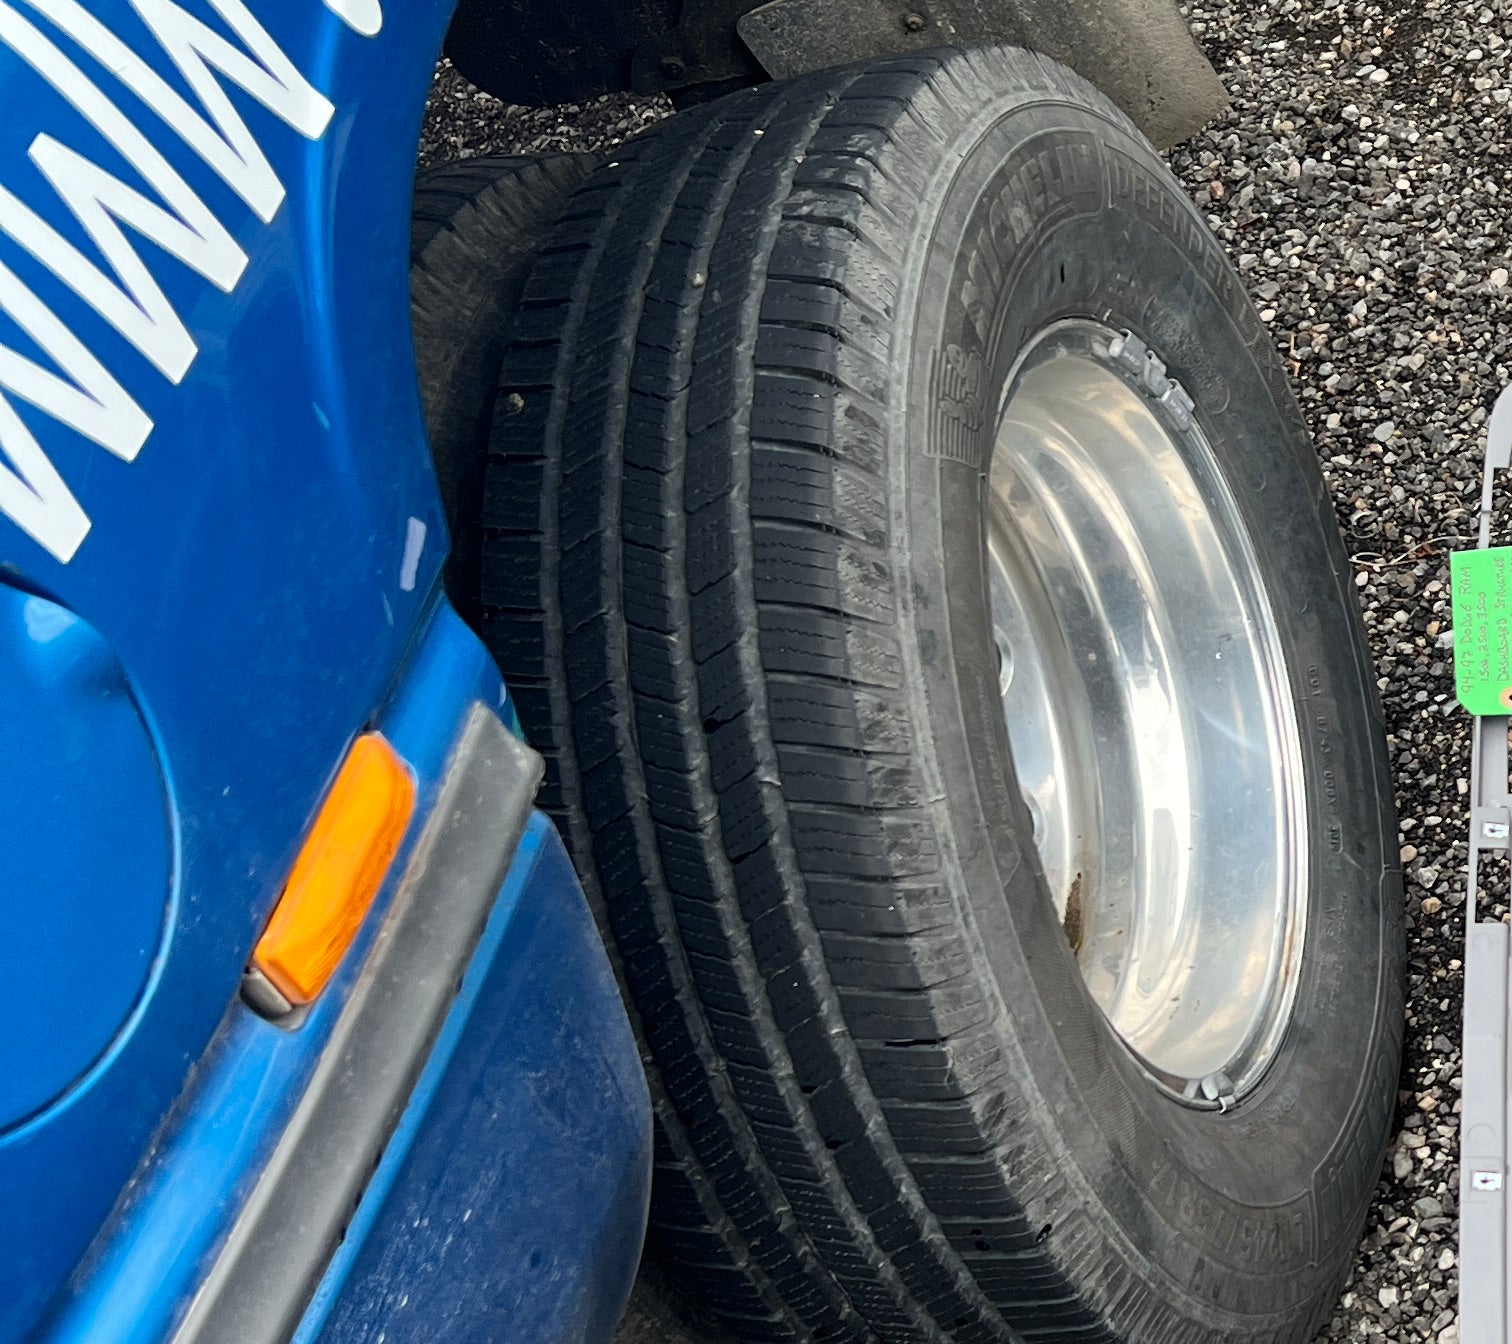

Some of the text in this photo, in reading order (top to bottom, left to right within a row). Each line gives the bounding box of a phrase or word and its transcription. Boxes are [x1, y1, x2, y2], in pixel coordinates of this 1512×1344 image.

[1113, 158, 1233, 301] DEFENDER
[1458, 565, 1472, 596] RAM
[1476, 591, 1488, 620] 3500
[1493, 555, 1510, 682] DASHBOARD STRUCTURE
[1461, 650, 1475, 694] 94-97
